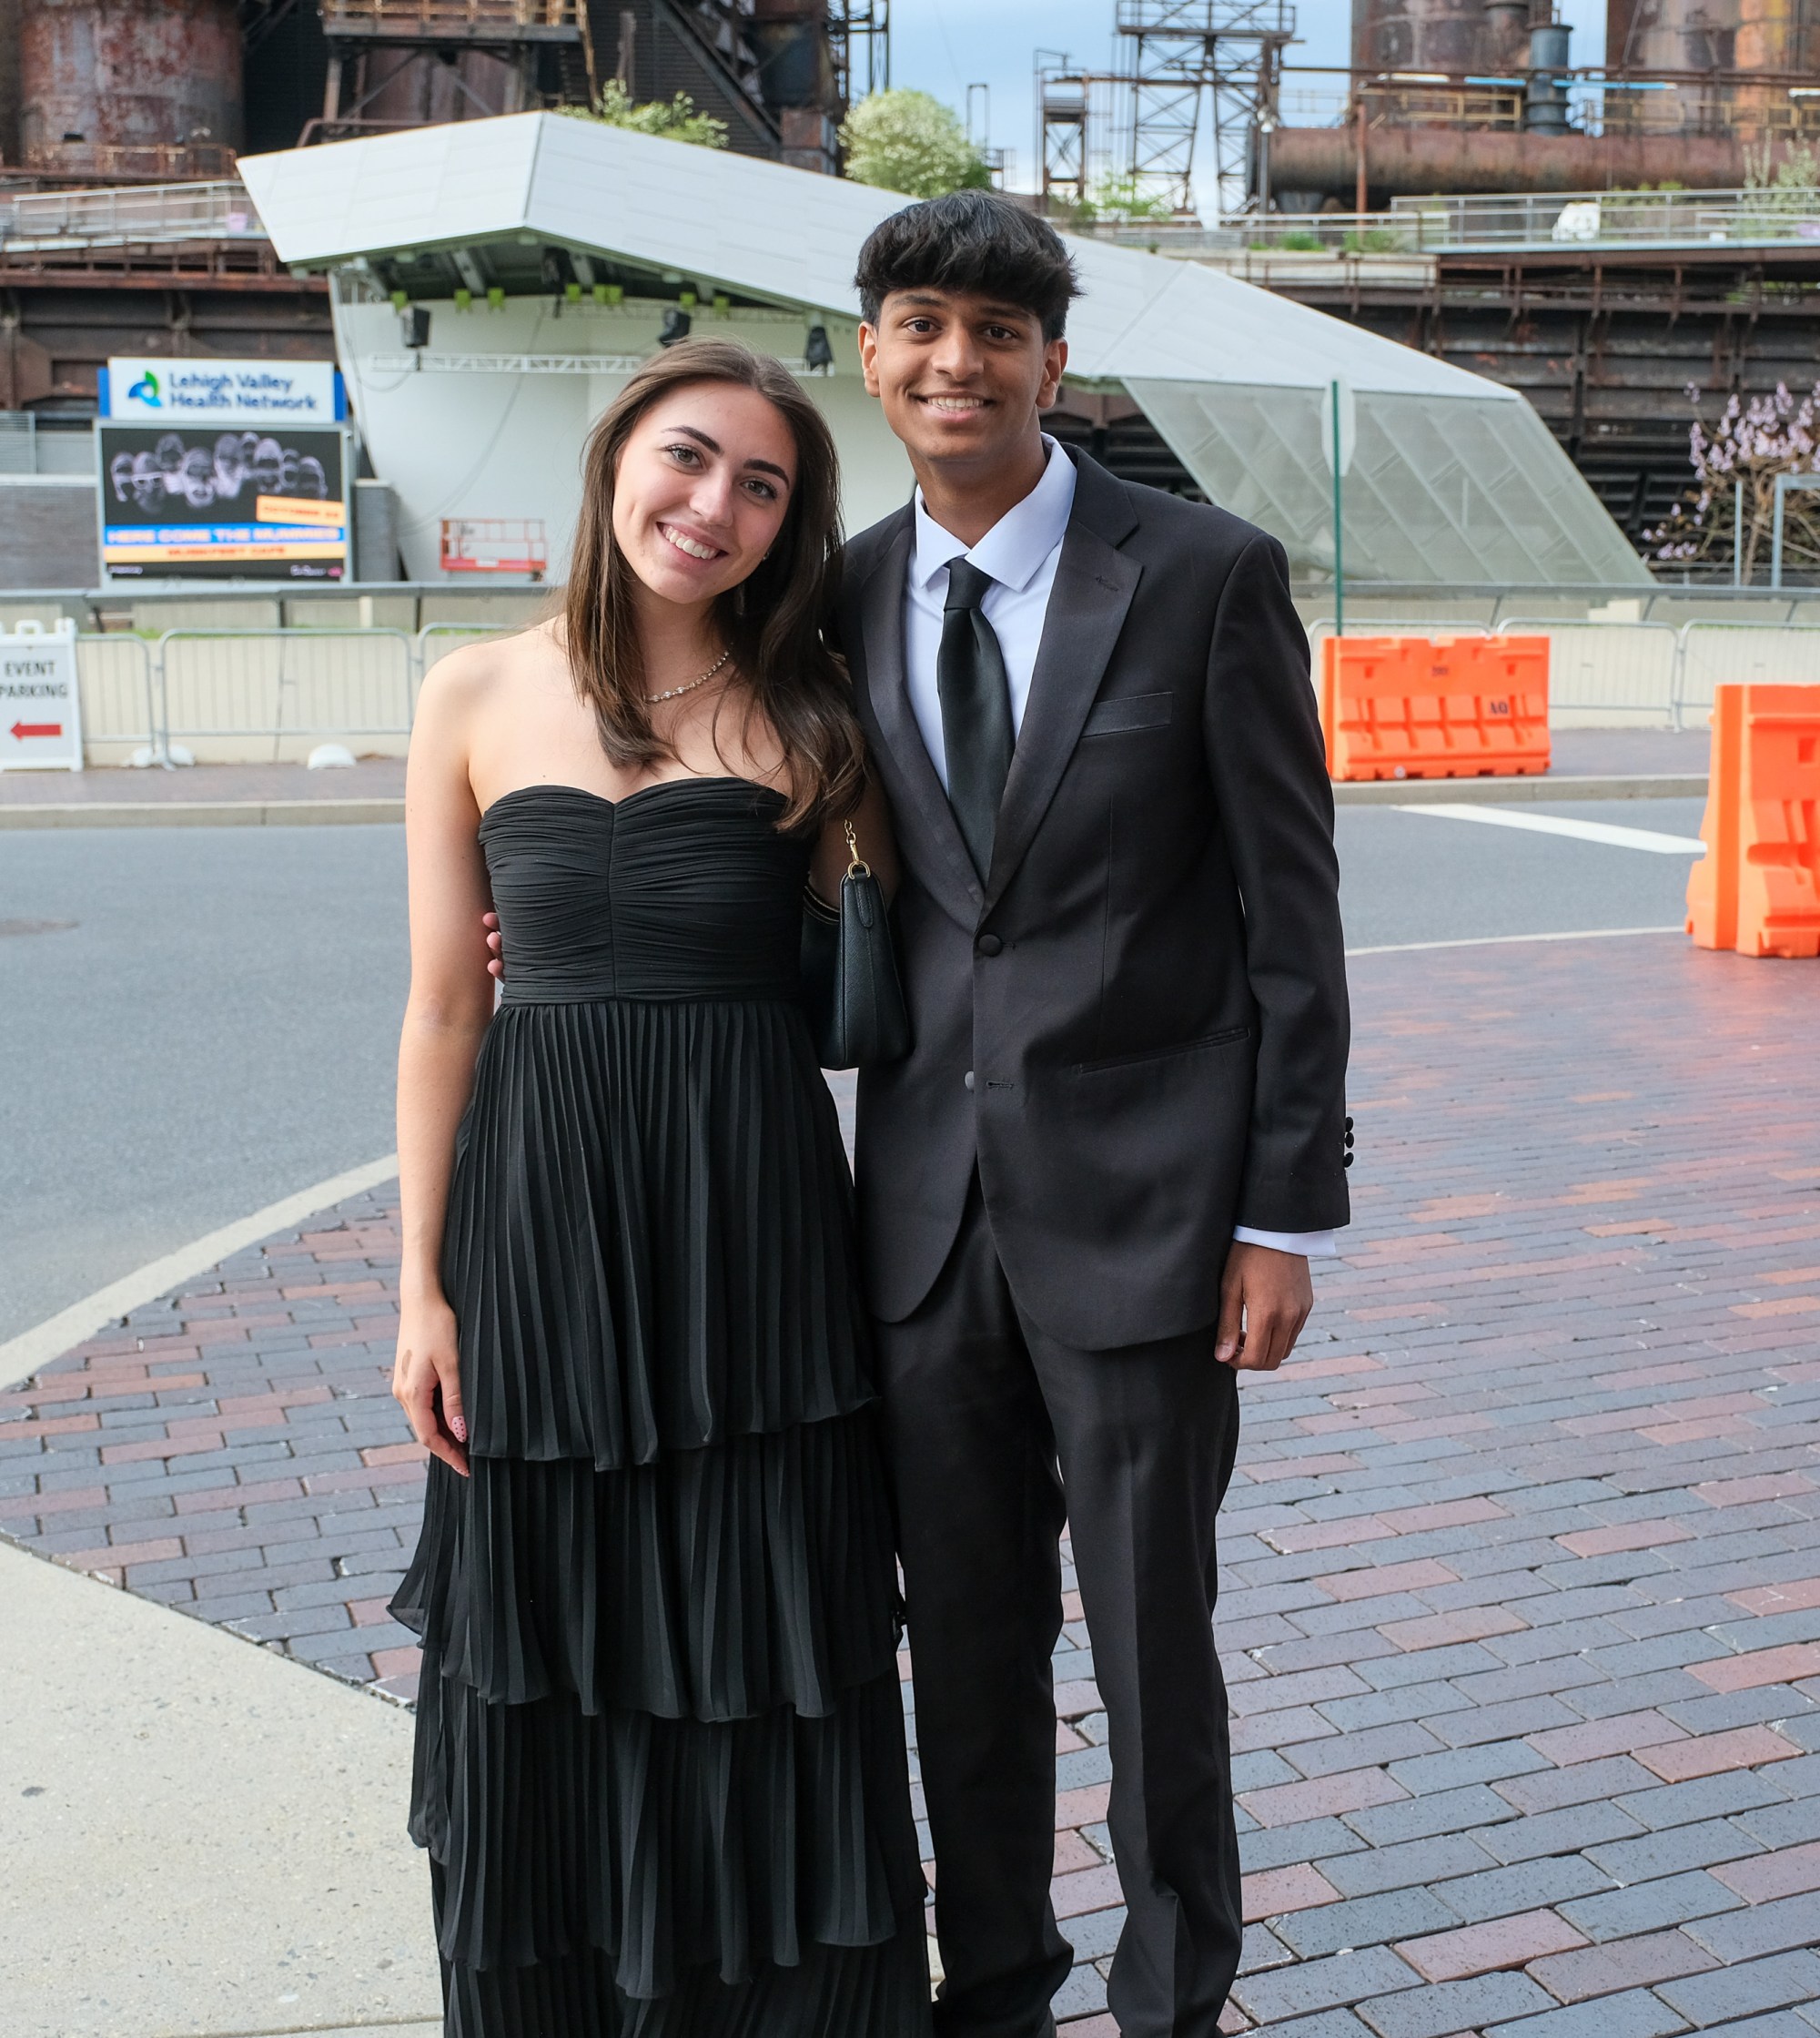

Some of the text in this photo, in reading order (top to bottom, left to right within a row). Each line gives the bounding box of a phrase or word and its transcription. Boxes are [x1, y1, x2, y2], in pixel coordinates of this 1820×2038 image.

[169, 372, 292, 393] Lehigh Valley
[170, 391, 316, 409] Health Network
[5, 661, 56, 676] EVENT
